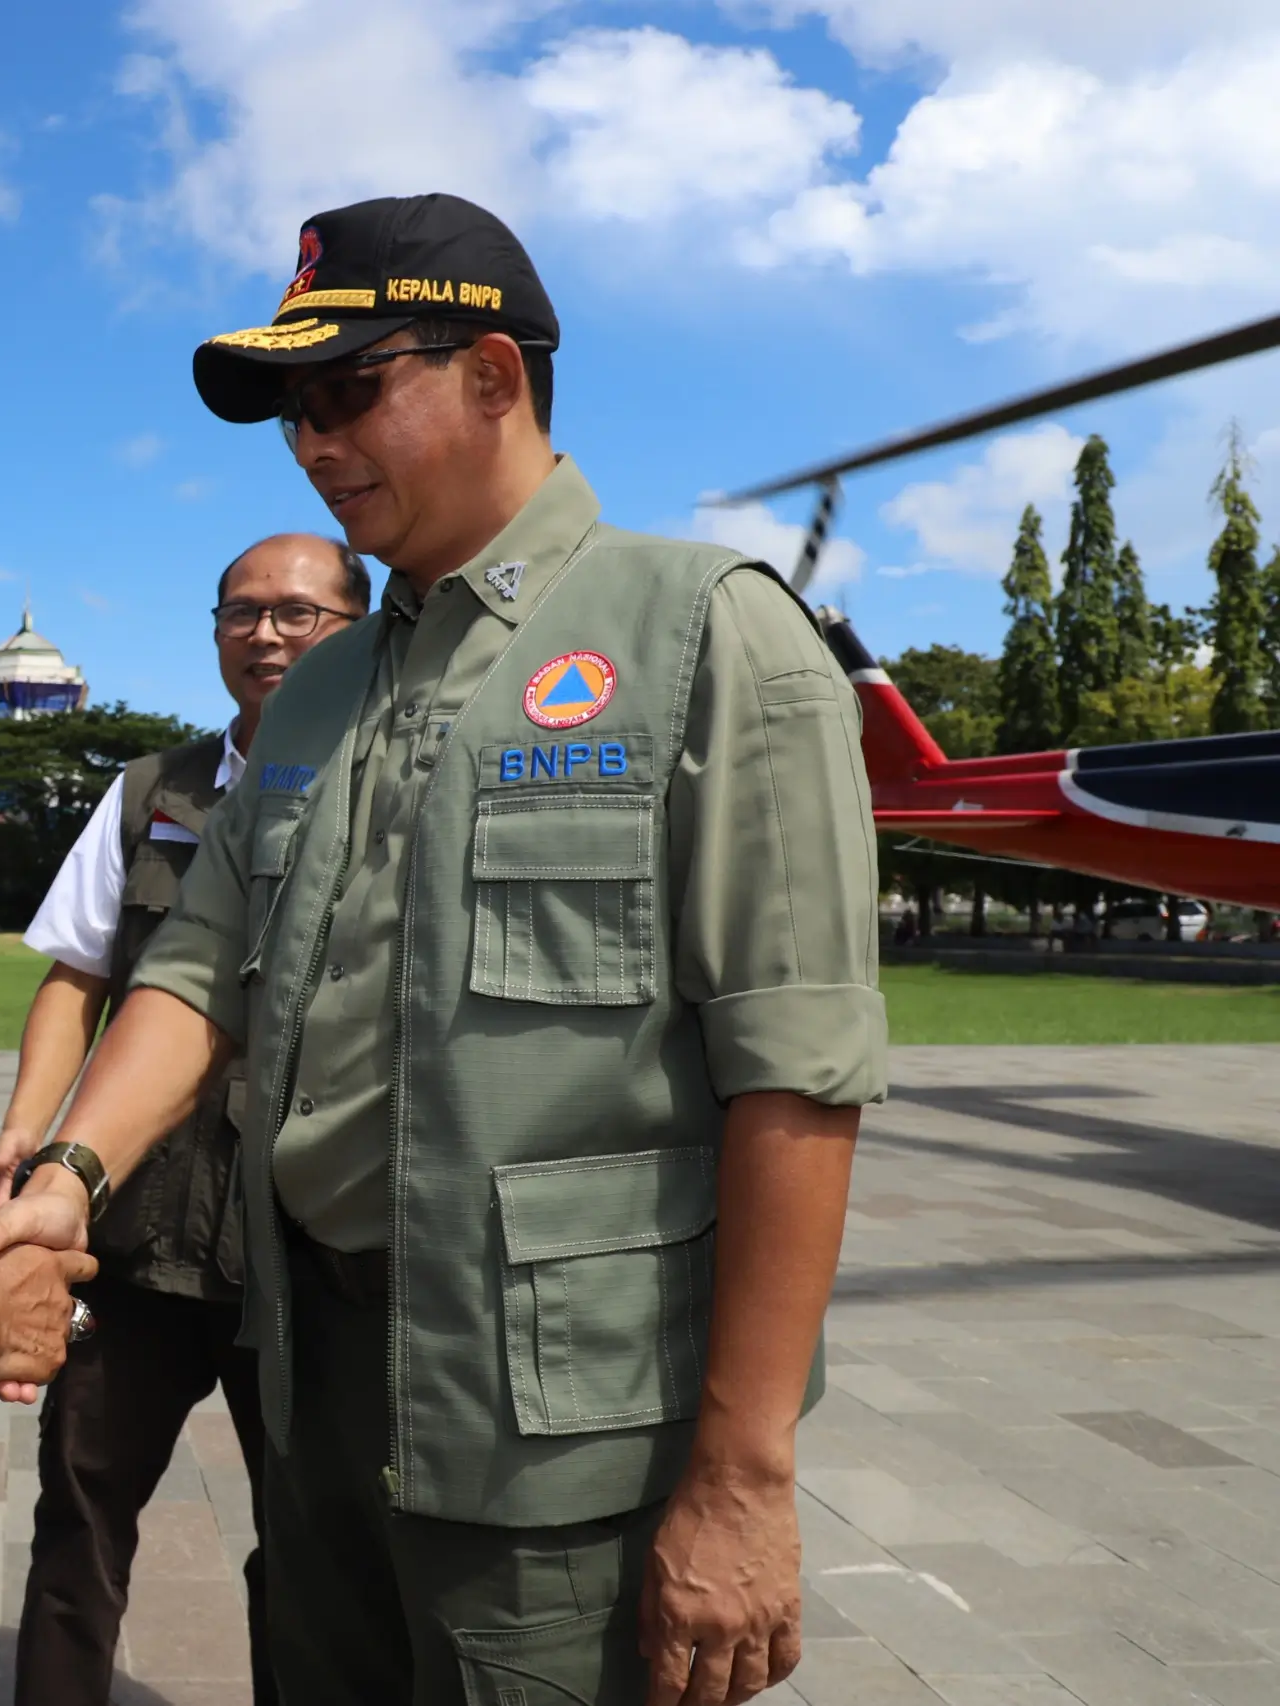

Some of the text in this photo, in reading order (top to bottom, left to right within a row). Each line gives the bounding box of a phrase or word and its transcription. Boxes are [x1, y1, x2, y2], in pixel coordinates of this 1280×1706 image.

[386, 278, 502, 311] KEPALA BNPB
[486, 573, 512, 598] BNPB
[532, 653, 610, 684] BADAN NASIONAL
[499, 741, 629, 783] BNPB
